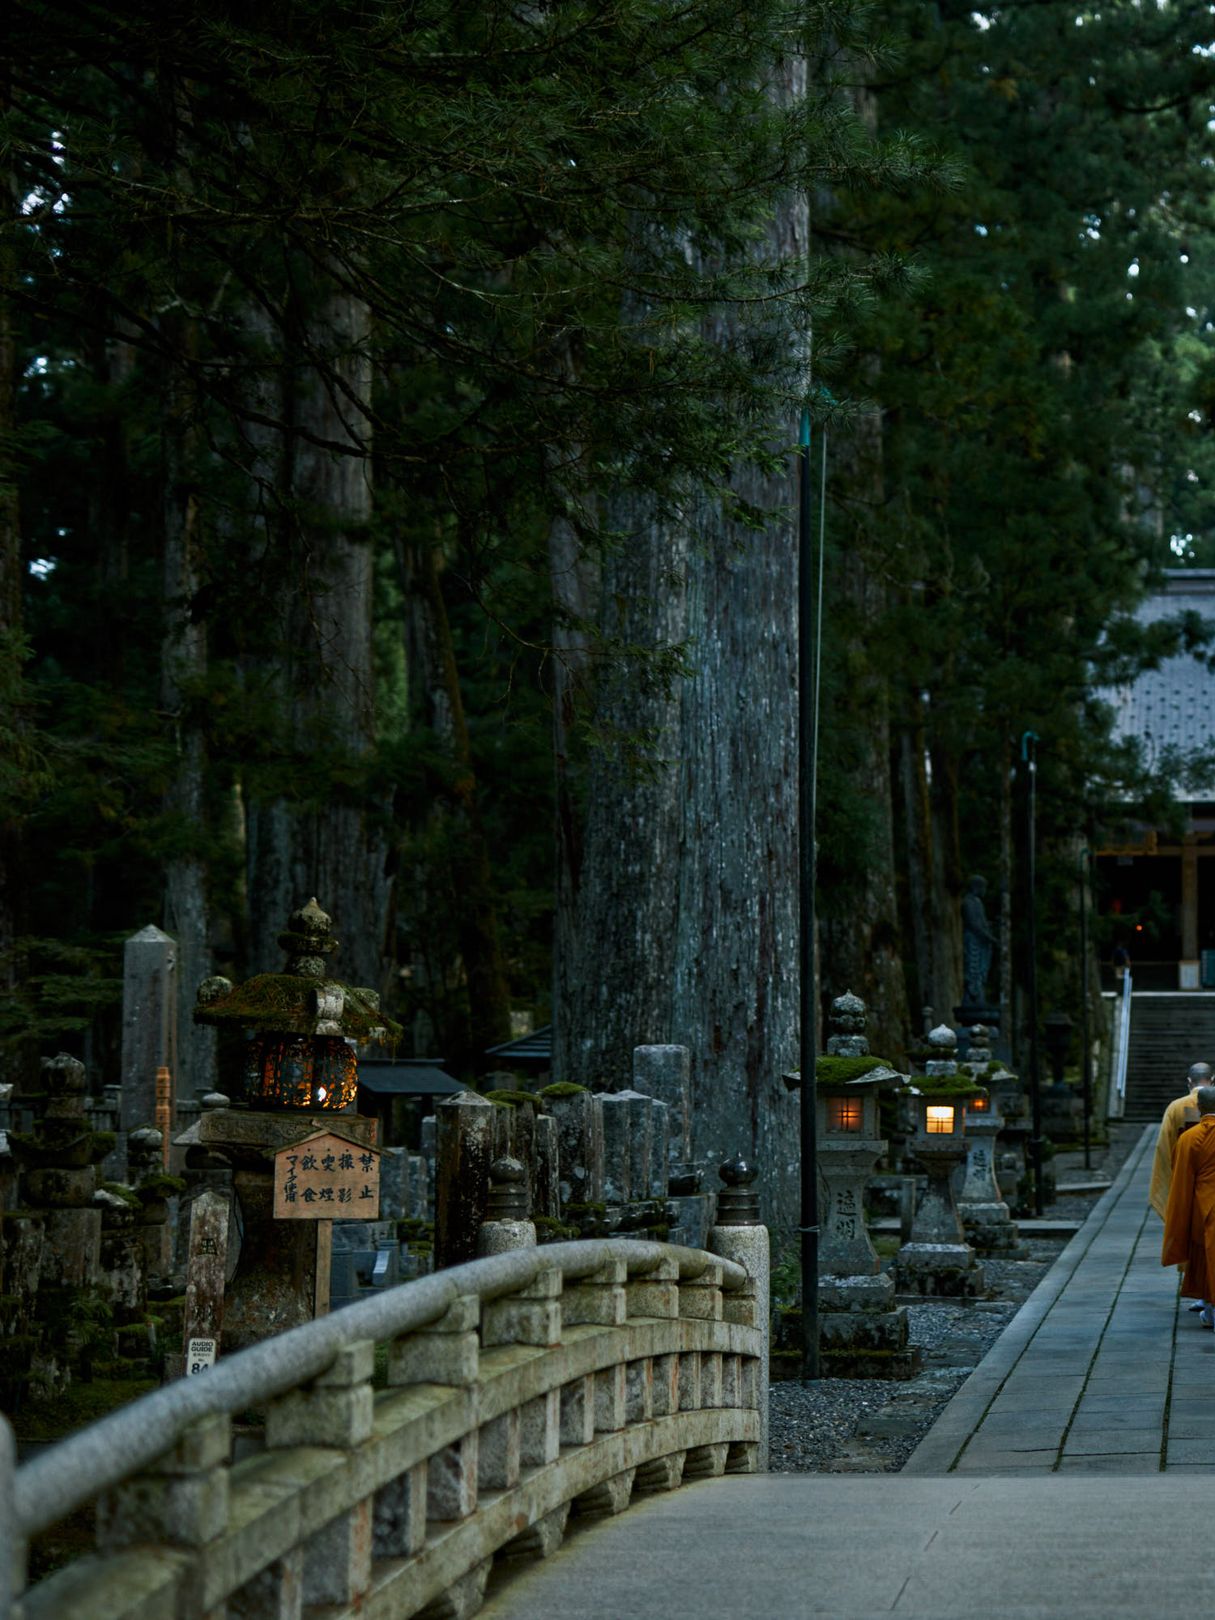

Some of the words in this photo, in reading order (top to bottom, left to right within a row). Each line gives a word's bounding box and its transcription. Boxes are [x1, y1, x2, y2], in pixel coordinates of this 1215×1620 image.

[284, 1155, 299, 1203] マイク使用
[301, 1154, 319, 1203] 飲食
[319, 1153, 336, 1203] 喫煙
[337, 1153, 355, 1203] 撮影
[358, 1152, 376, 1200] 禁止
